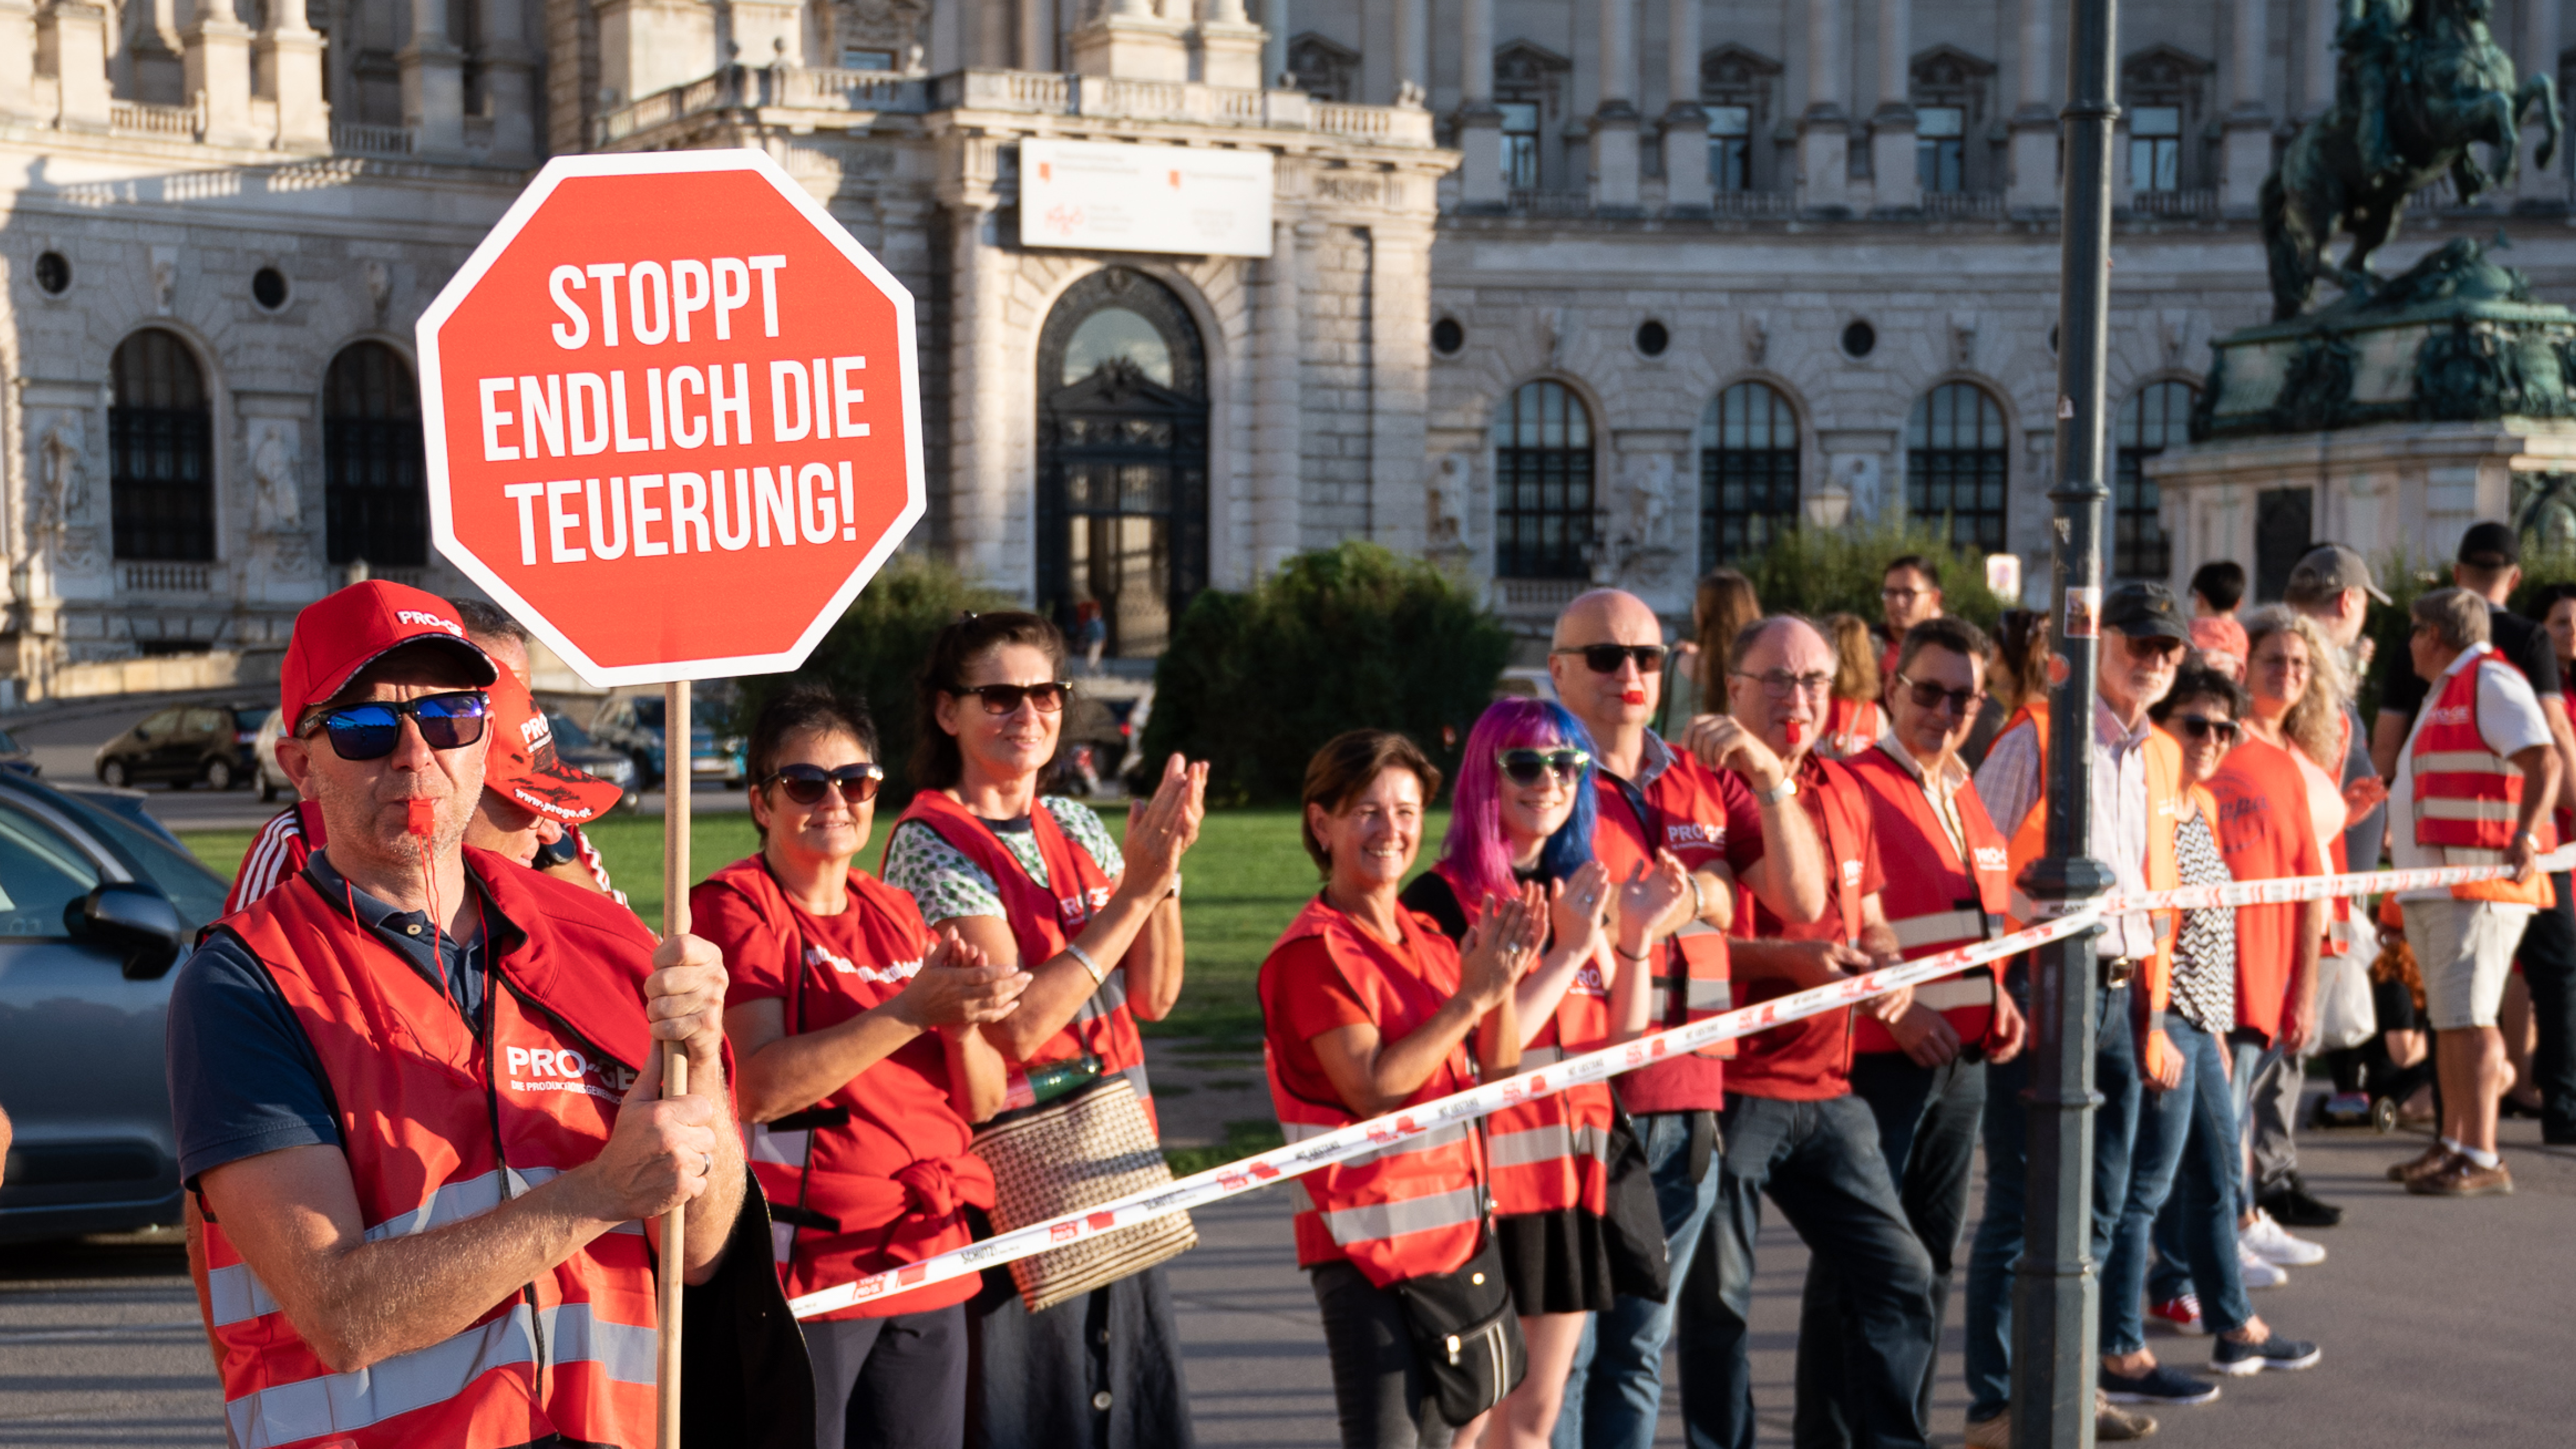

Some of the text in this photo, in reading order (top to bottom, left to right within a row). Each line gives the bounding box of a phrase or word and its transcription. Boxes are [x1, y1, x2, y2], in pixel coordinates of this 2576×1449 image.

[548, 255, 786, 350] STOPPT
[478, 356, 870, 462] ENDLICH DIE
[504, 461, 856, 566] TEUERUNG!
[515, 788, 592, 819] www.proge.at
[511, 1080, 525, 1091] DIE
